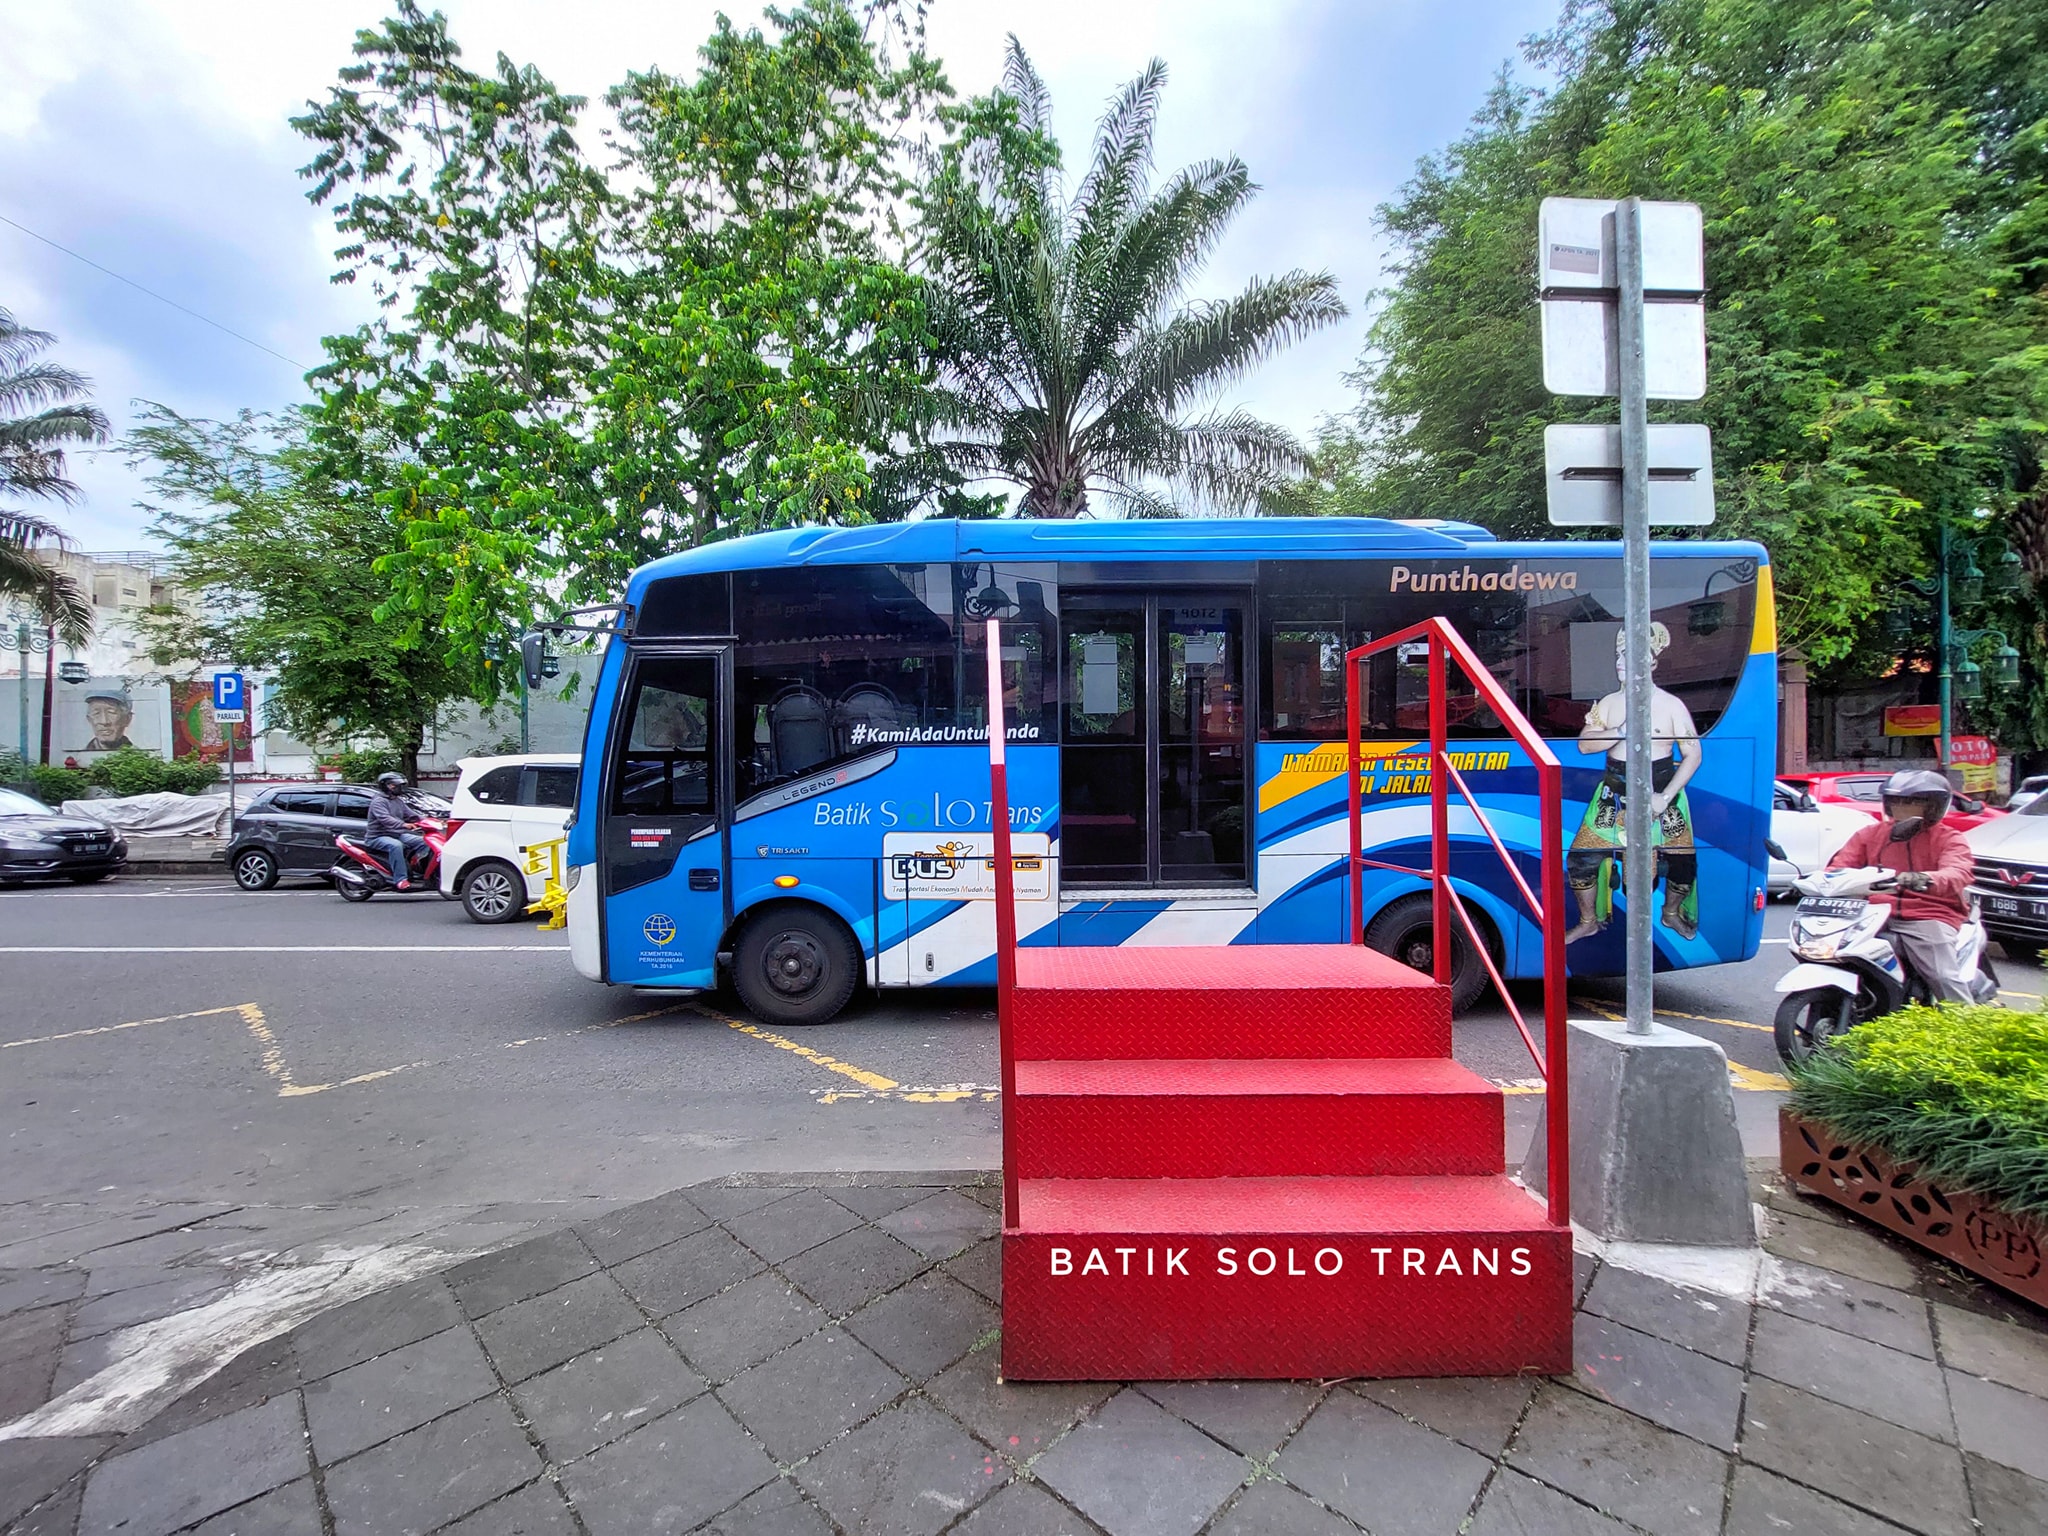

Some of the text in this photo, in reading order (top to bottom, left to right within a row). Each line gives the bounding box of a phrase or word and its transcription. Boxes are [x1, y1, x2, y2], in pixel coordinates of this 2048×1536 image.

[1390, 565, 1577, 592] Punthadewa
[220, 677, 237, 704] P
[217, 712, 241, 720] PARALEL
[851, 723, 1039, 745] #KamiAdaUntuknda
[1951, 739, 1989, 753] OTO
[1280, 752, 1378, 773] UTAMAAN
[1383, 751, 1511, 772] KESELMATAN
[814, 802, 872, 826] Batik
[983, 801, 1042, 825] Tans
[892, 885, 930, 894] Tranportasi
[1991, 897, 2019, 912] 1686
[1050, 1246, 1533, 1277] BATIK SOLO TRANS
